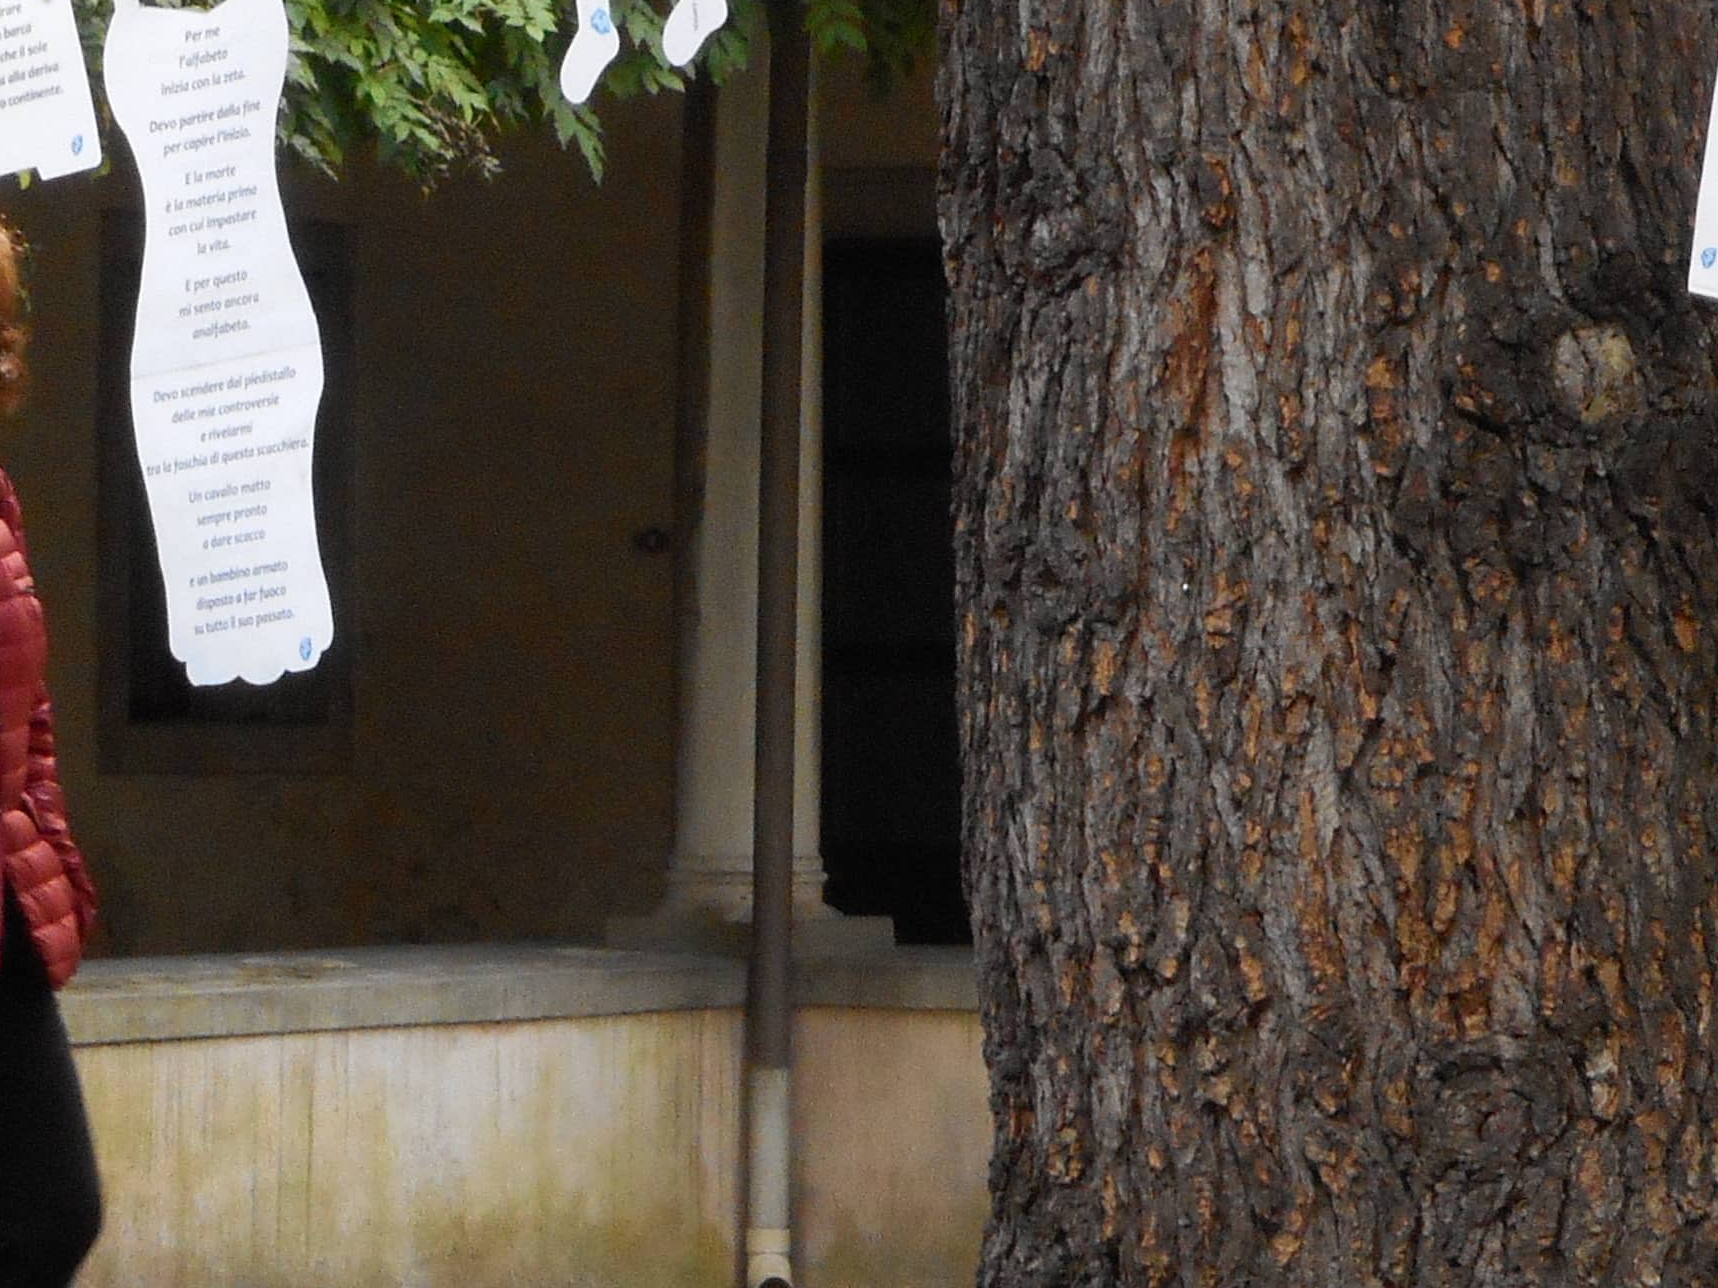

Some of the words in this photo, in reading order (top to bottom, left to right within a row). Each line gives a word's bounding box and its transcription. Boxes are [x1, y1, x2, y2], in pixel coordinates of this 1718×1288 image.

[3, 24, 32, 40] barca
[185, 30, 203, 43] Per
[205, 26, 220, 40] me
[0, 50, 17, 64] che
[19, 45, 25, 58] il
[27, 40, 48, 56] sole
[179, 48, 228, 70] l'alfabeto
[7, 70, 27, 84] alla
[27, 62, 59, 79] deriva
[161, 80, 189, 96] inizia
[191, 78, 211, 91] con
[212, 72, 221, 86] la
[223, 69, 246, 84] zeta.
[8, 85, 64, 107] continente.
[149, 120, 177, 134] Devo
[179, 110, 215, 132] partire
[216, 103, 241, 120] dalla
[242, 100, 261, 118] fine
[163, 141, 182, 159] per
[182, 134, 215, 152] capire
[185, 172, 191, 186] E
[193, 170, 203, 184] la
[205, 164, 236, 181] morte
[165, 200, 171, 214] è
[174, 198, 184, 212] la
[186, 190, 226, 209] materia
[227, 185, 257, 205] prima
[168, 224, 187, 238] con
[206, 209, 257, 230] impastare
[197, 242, 207, 256] la
[209, 239, 231, 253] vita.
[185, 279, 191, 293] E
[193, 278, 211, 295] per
[213, 270, 248, 289] questo
[179, 304, 192, 318] mi
[193, 300, 222, 316] sento
[224, 293, 259, 309] ancora
[192, 319, 251, 340] analfabeta.
